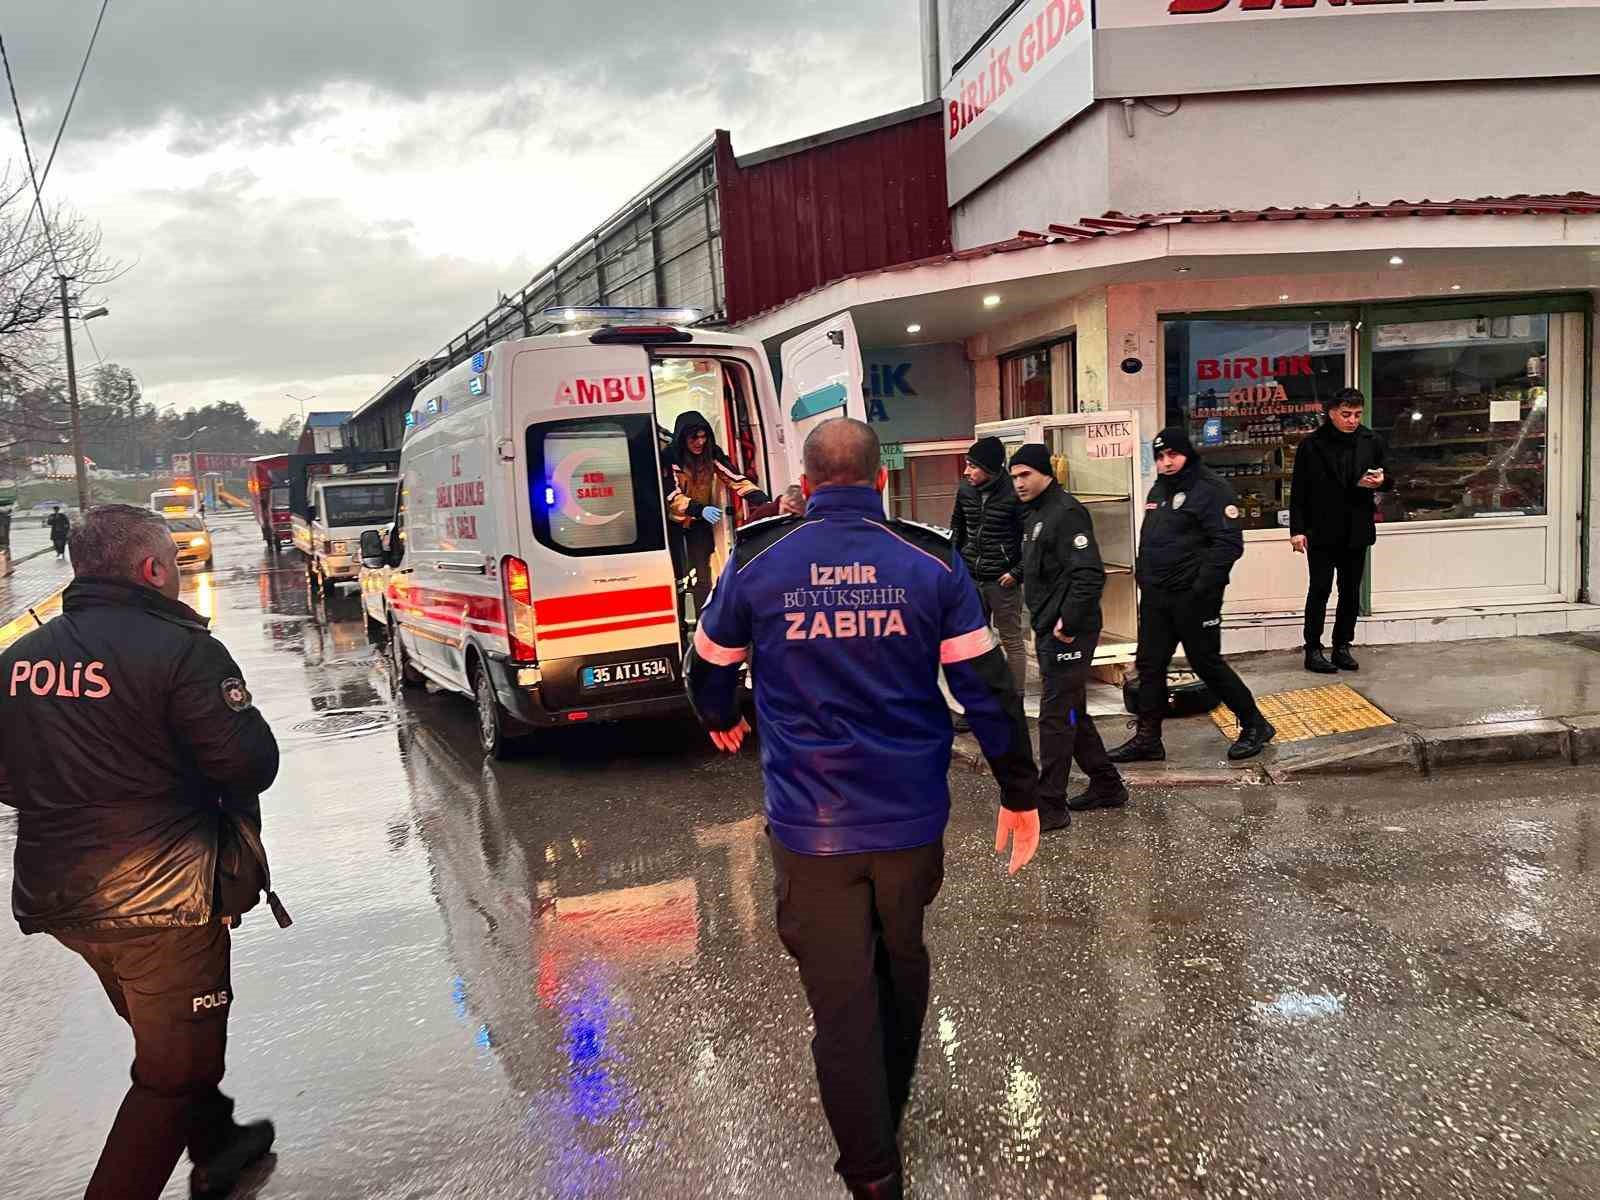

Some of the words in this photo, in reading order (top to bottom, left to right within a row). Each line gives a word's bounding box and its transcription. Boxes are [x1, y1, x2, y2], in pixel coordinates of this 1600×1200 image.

[949, 45, 1013, 139] BİRLİK
[1018, 0, 1085, 73] GIDA
[553, 376, 646, 406] AMBU
[1087, 423, 1130, 439] EKMEK
[1095, 443, 1108, 458] 10
[1111, 443, 1124, 457] TL
[810, 562, 877, 586] İZMİR
[784, 585, 907, 609] BÜYÜKŞEHİR
[784, 610, 908, 640] ZABITA
[593, 667, 611, 683] 35
[615, 663, 640, 680] ATJ
[642, 660, 666, 676] 534
